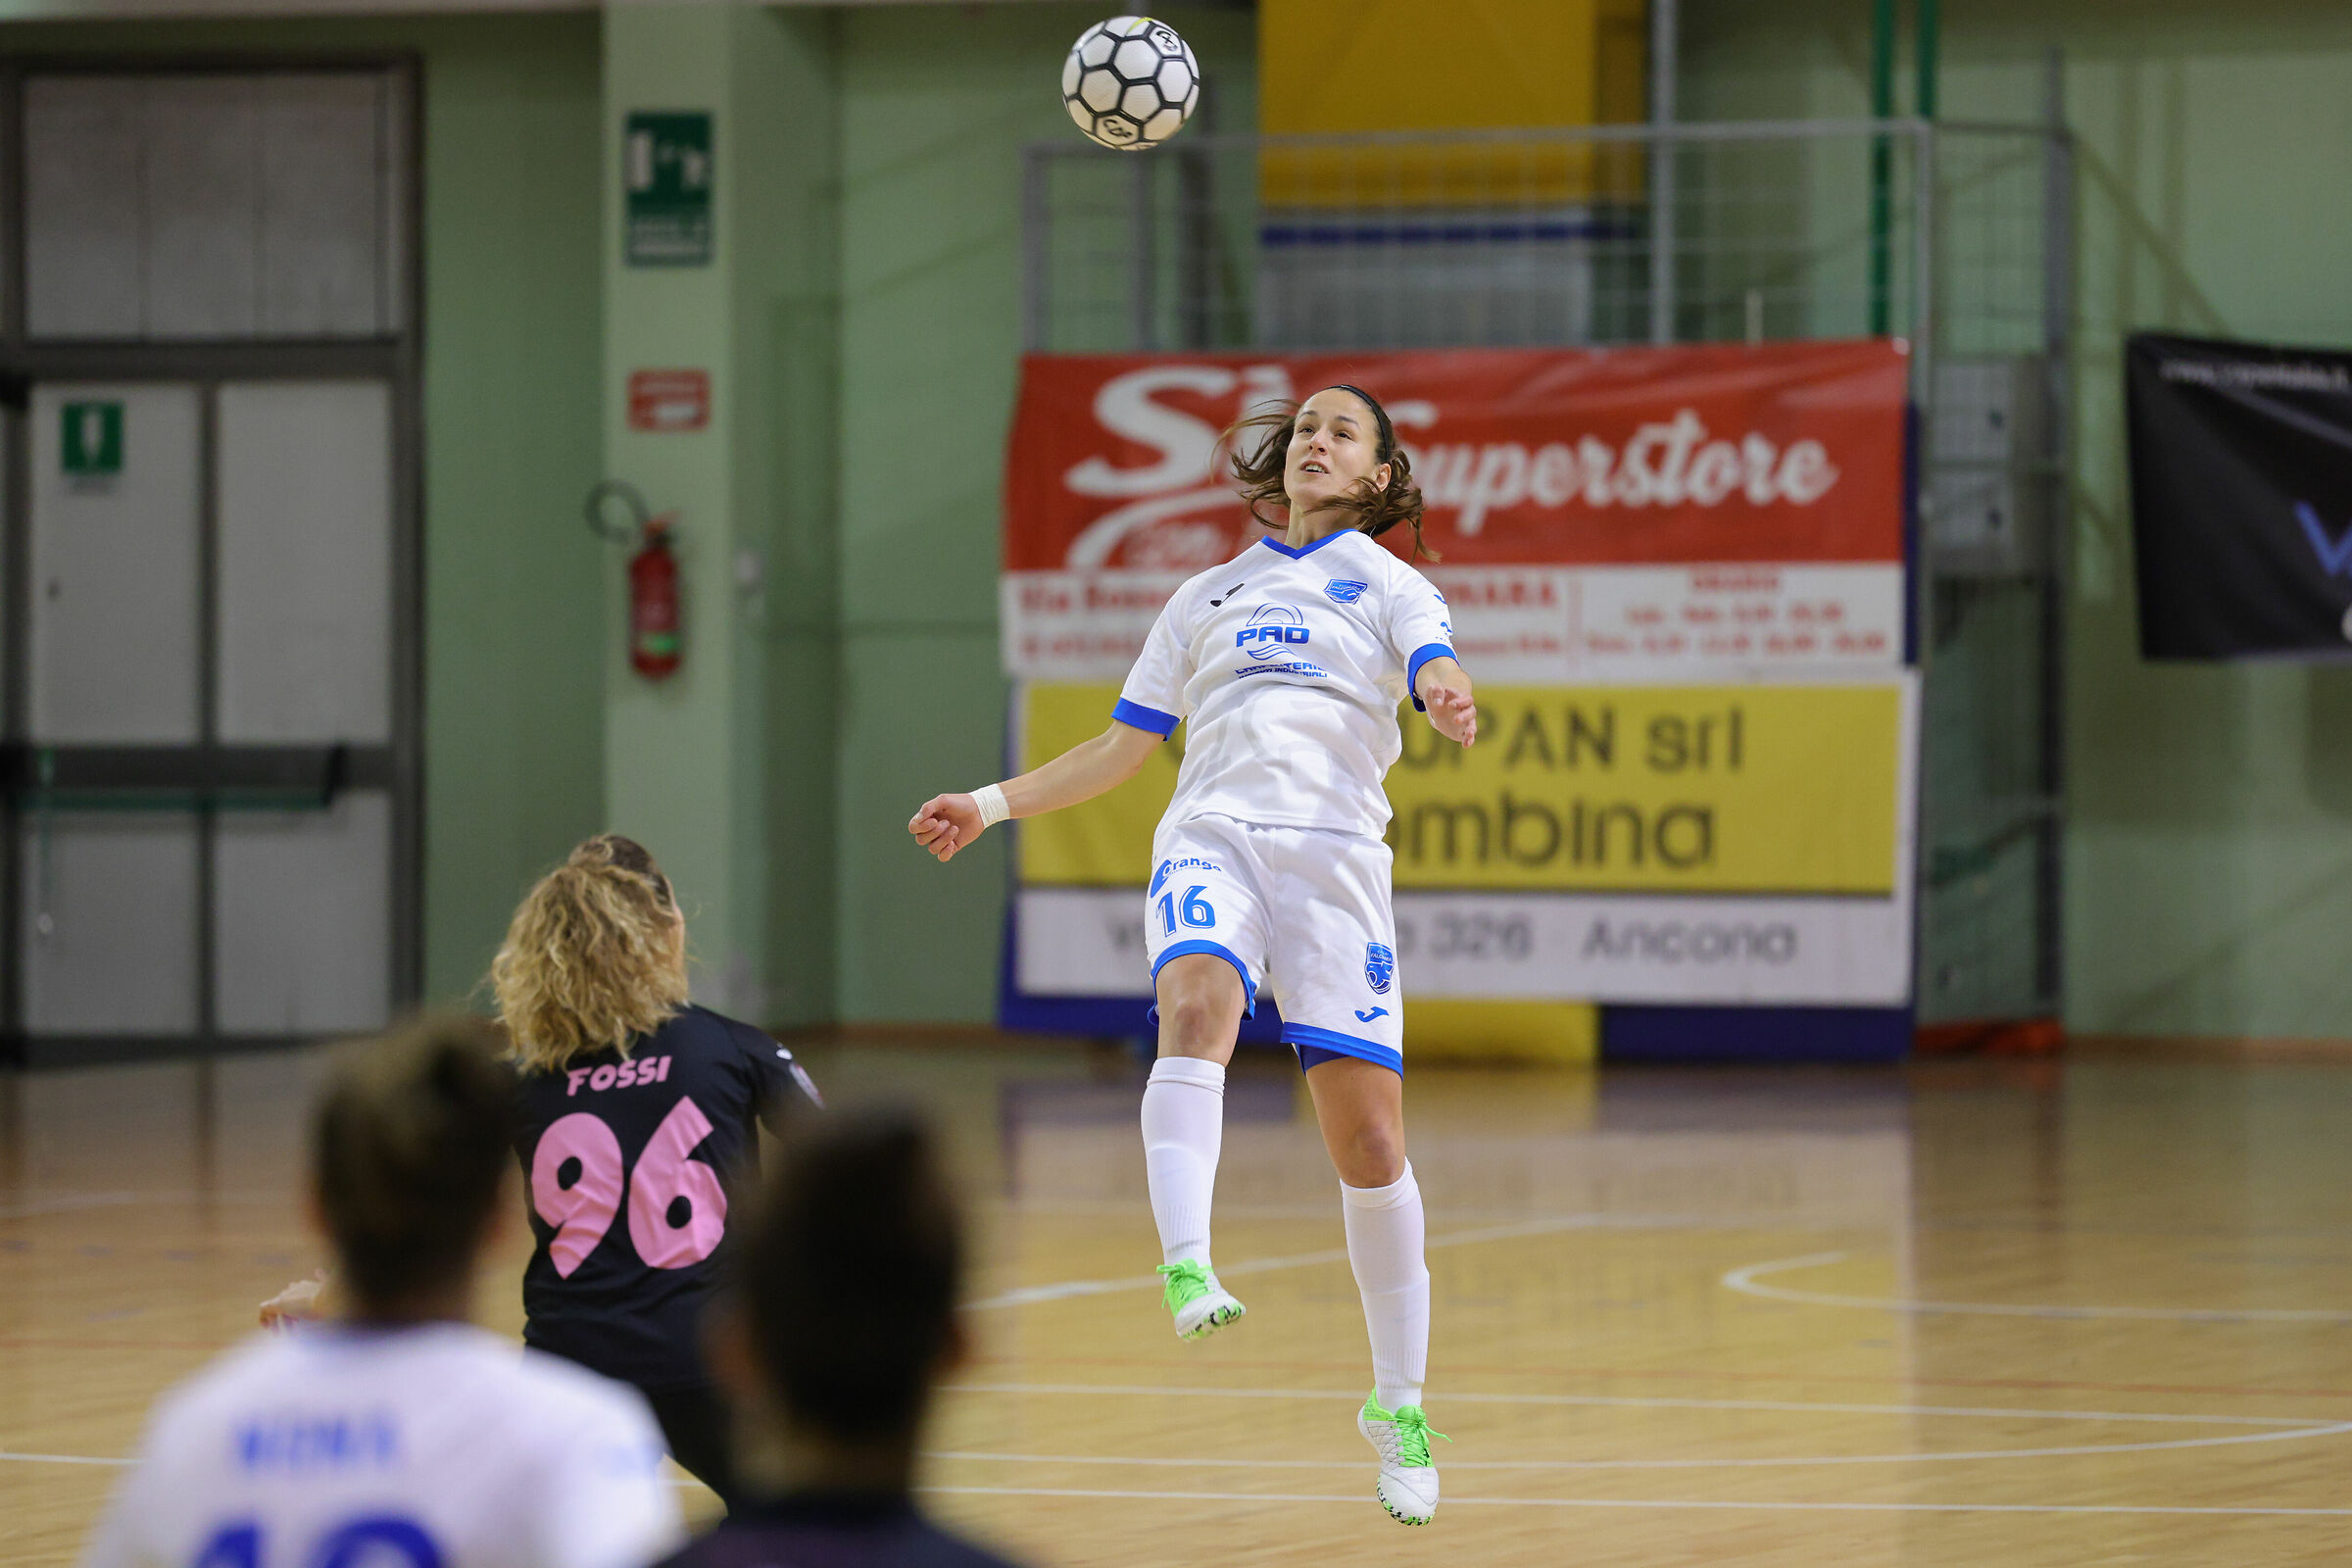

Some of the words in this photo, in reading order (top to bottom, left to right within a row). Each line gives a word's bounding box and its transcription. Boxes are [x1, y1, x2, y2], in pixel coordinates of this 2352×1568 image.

[1387, 400, 1838, 535] uperstore
[1236, 625, 1310, 648] PAD
[1396, 702, 1617, 771] UPAN
[1643, 701, 1744, 774] srl
[1155, 885, 1216, 937] 16
[1581, 914, 1798, 963] Ancona
[565, 1054, 673, 1097] FOSSI
[530, 1094, 728, 1281] 96
